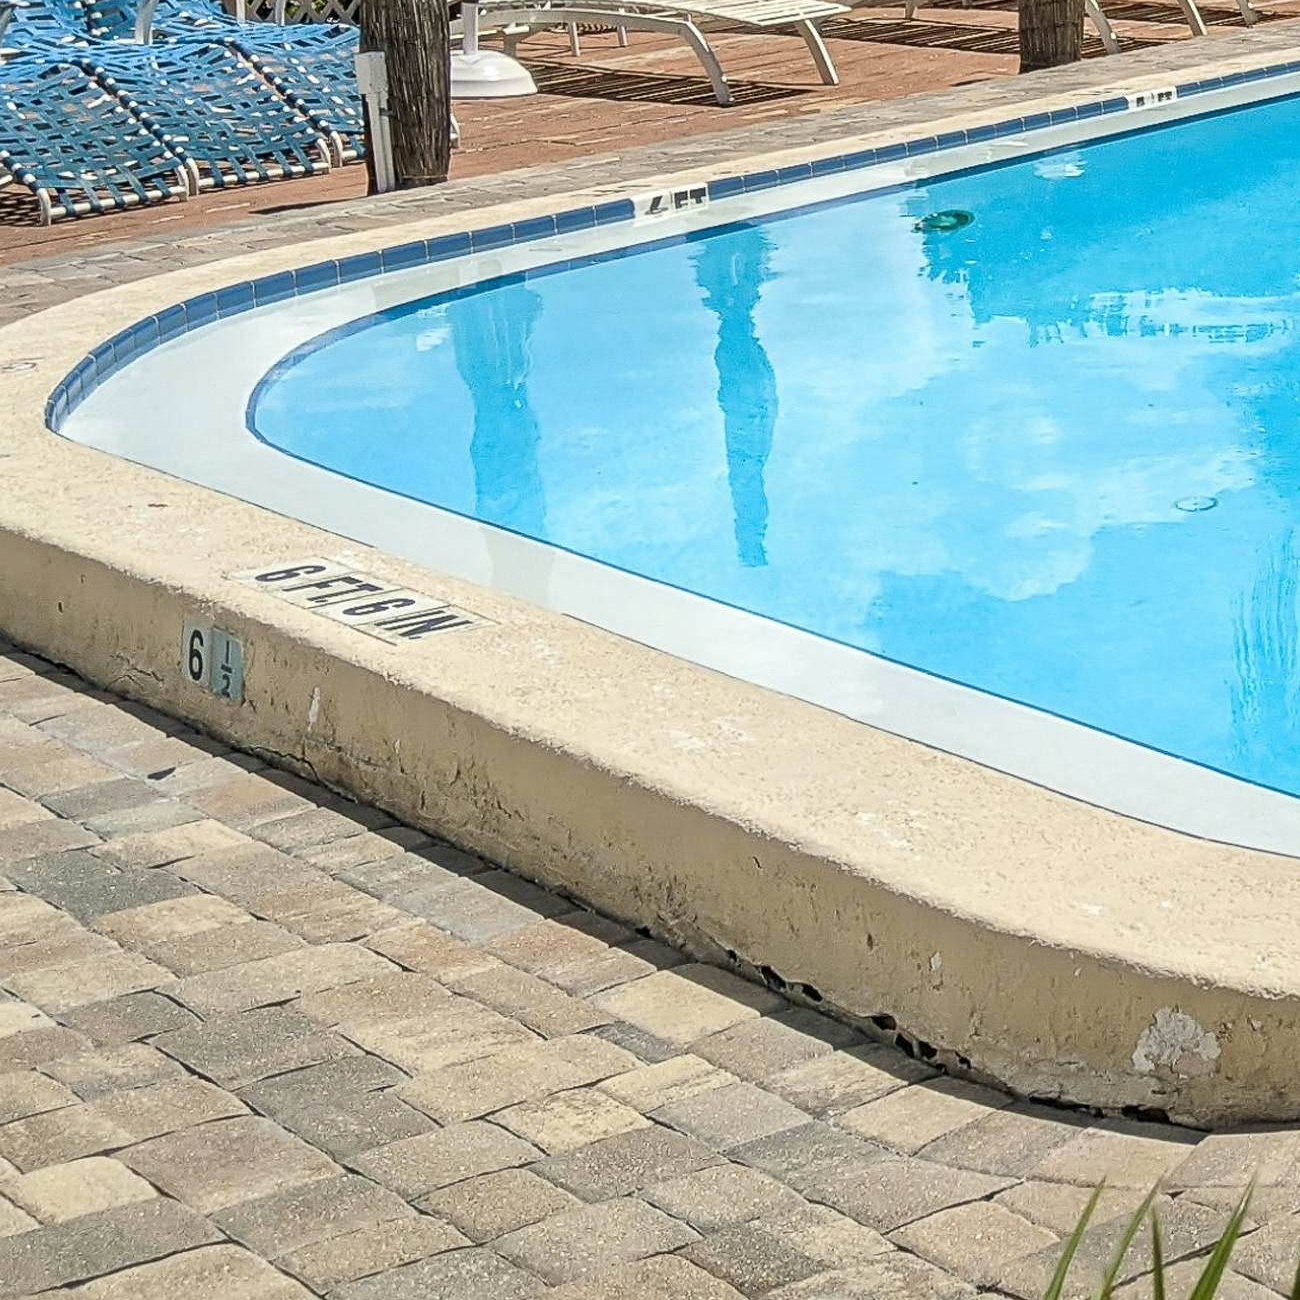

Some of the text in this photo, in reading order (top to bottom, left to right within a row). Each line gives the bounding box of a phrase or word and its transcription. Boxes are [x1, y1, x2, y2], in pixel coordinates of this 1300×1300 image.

[254, 564, 327, 583] 6
[342, 597, 416, 617] 6
[189, 628, 204, 681] 6
